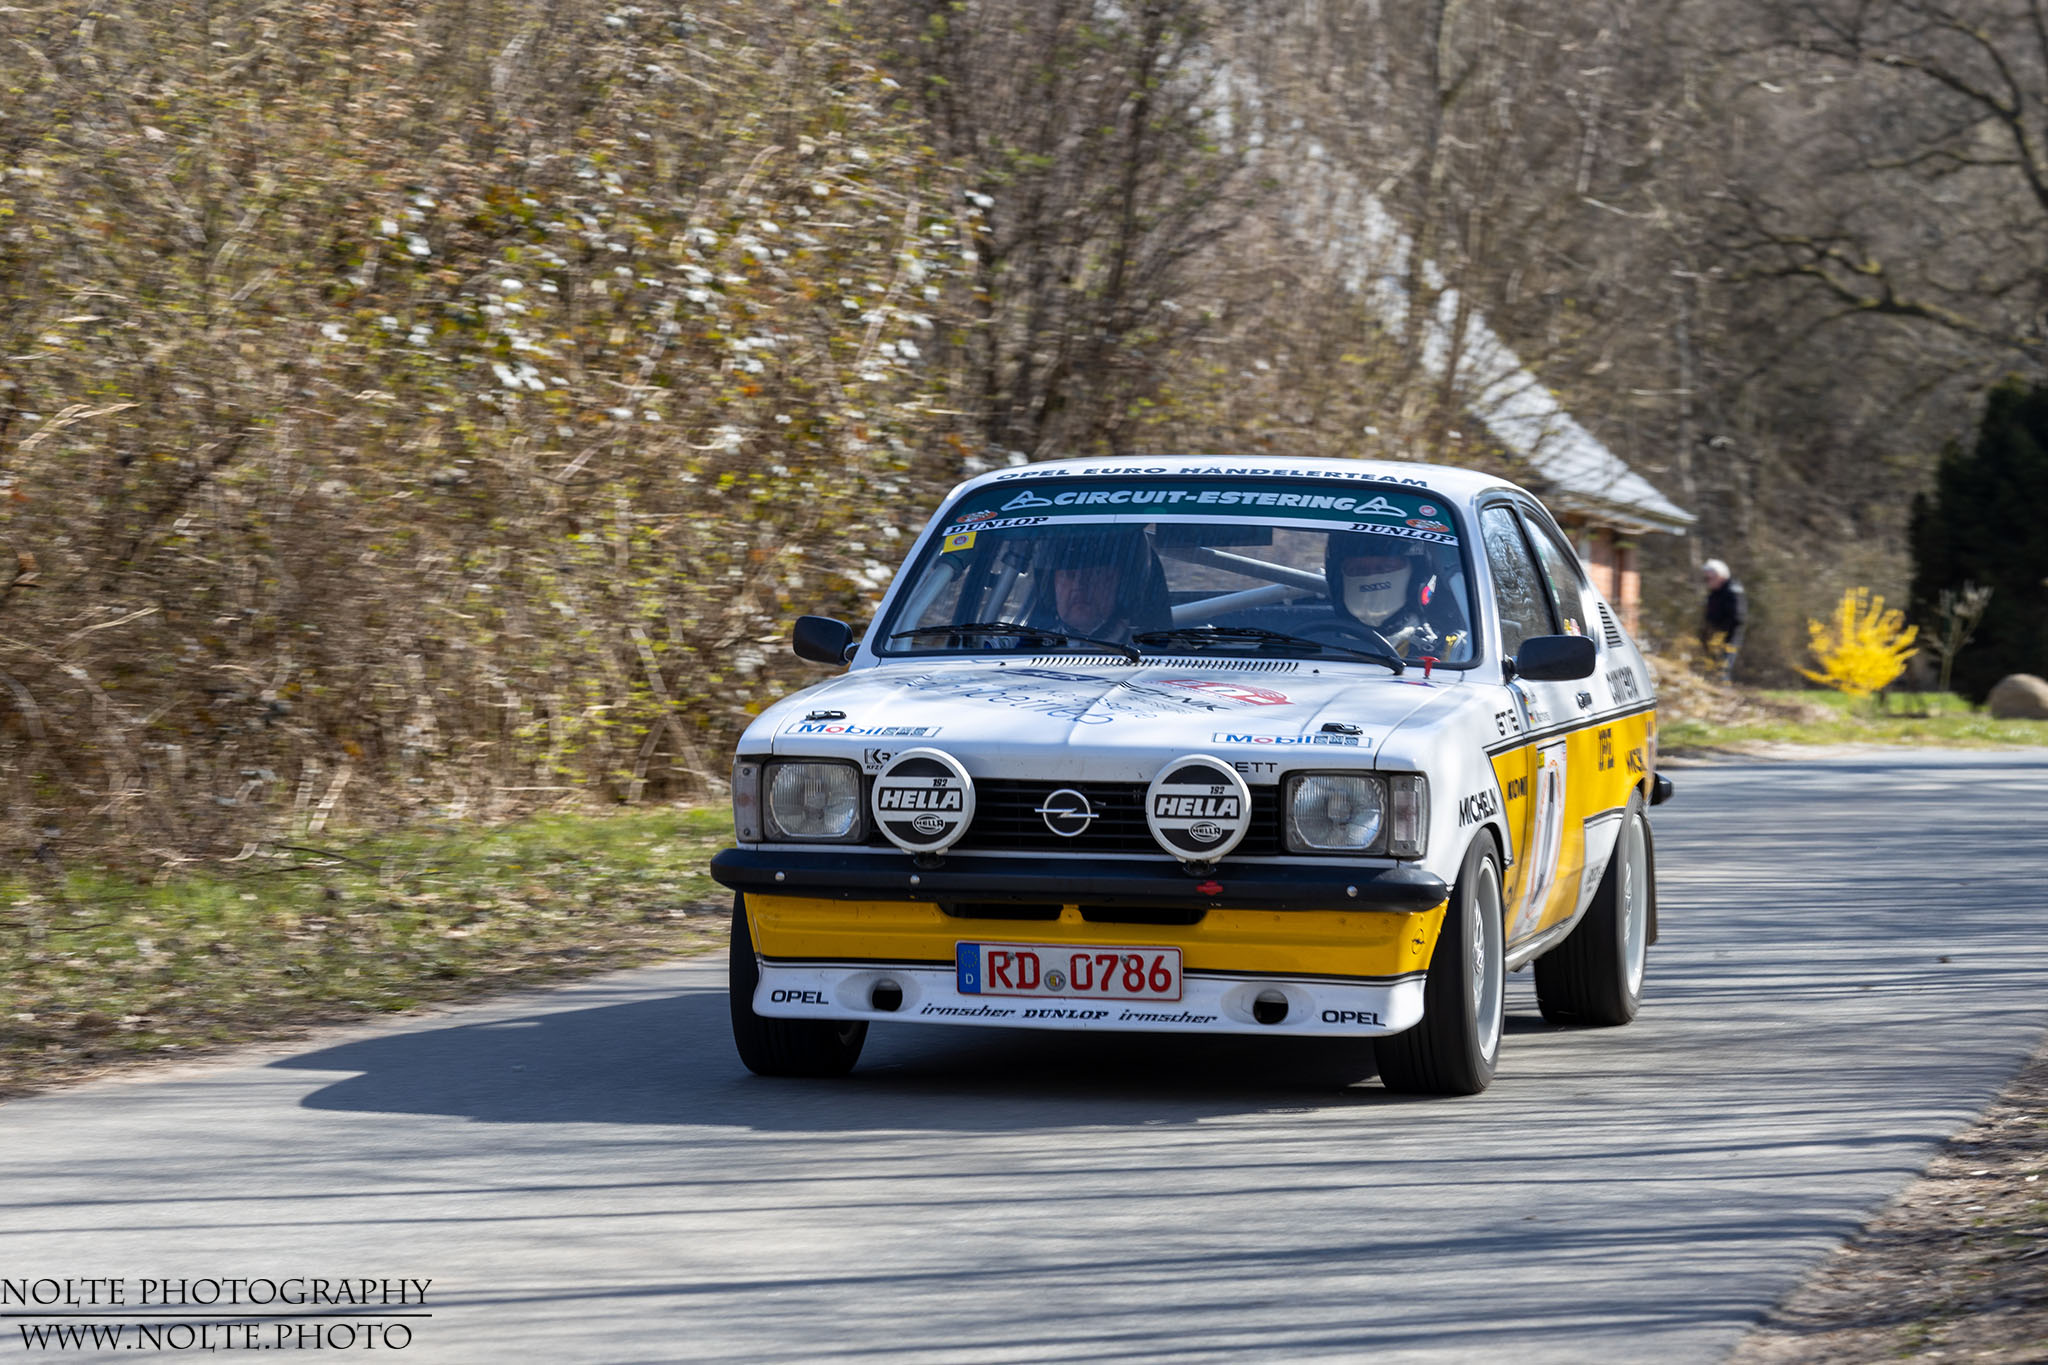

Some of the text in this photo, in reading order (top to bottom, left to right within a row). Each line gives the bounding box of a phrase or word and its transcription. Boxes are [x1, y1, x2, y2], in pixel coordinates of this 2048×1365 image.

[997, 467, 1428, 488] OPEL EURO HÄNDELERTEAM
[1053, 490, 1357, 511] CIRCUIT-ESTERING
[946, 517, 1049, 534] DUNLOP
[1350, 523, 1455, 543] DUNLOP
[800, 724, 882, 735] Mobil
[1226, 734, 1312, 744] Mobil
[1226, 761, 1279, 773] ETT
[880, 789, 961, 809] HELLA
[1156, 797, 1238, 817] HELLA
[915, 818, 944, 828] HELLA
[1191, 826, 1221, 836] HELLA
[965, 951, 1173, 993] D RD 0786
[771, 989, 829, 1005] OPEL
[920, 1002, 1217, 1024] irmscher DUNLOP irmscher
[1322, 1009, 1387, 1027] OPEL
